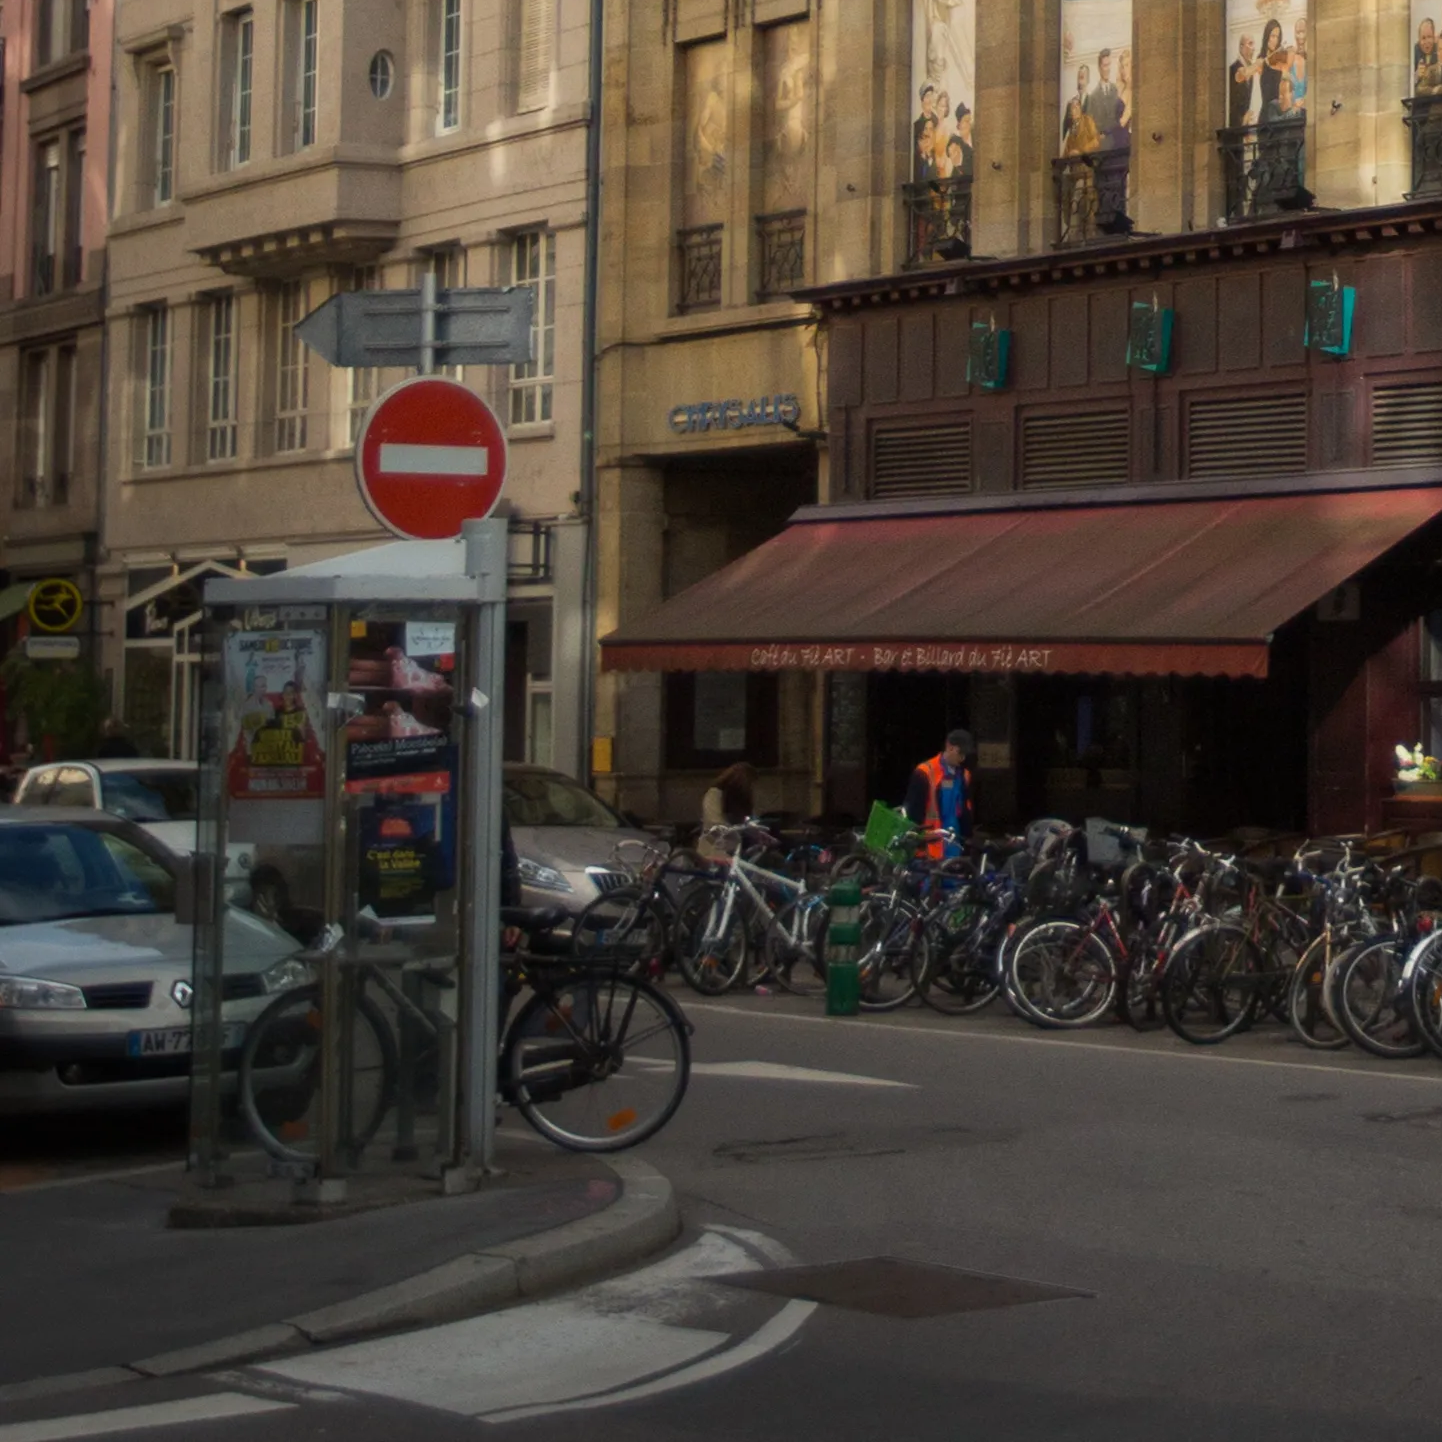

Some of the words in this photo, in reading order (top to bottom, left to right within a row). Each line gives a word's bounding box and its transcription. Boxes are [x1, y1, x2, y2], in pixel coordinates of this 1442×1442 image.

[750, 643, 780, 666] Café
[822, 646, 856, 665] ART
[873, 646, 899, 665] Bar
[916, 643, 966, 666] Billard
[969, 644, 988, 666] du
[1014, 647, 1053, 667] ART
